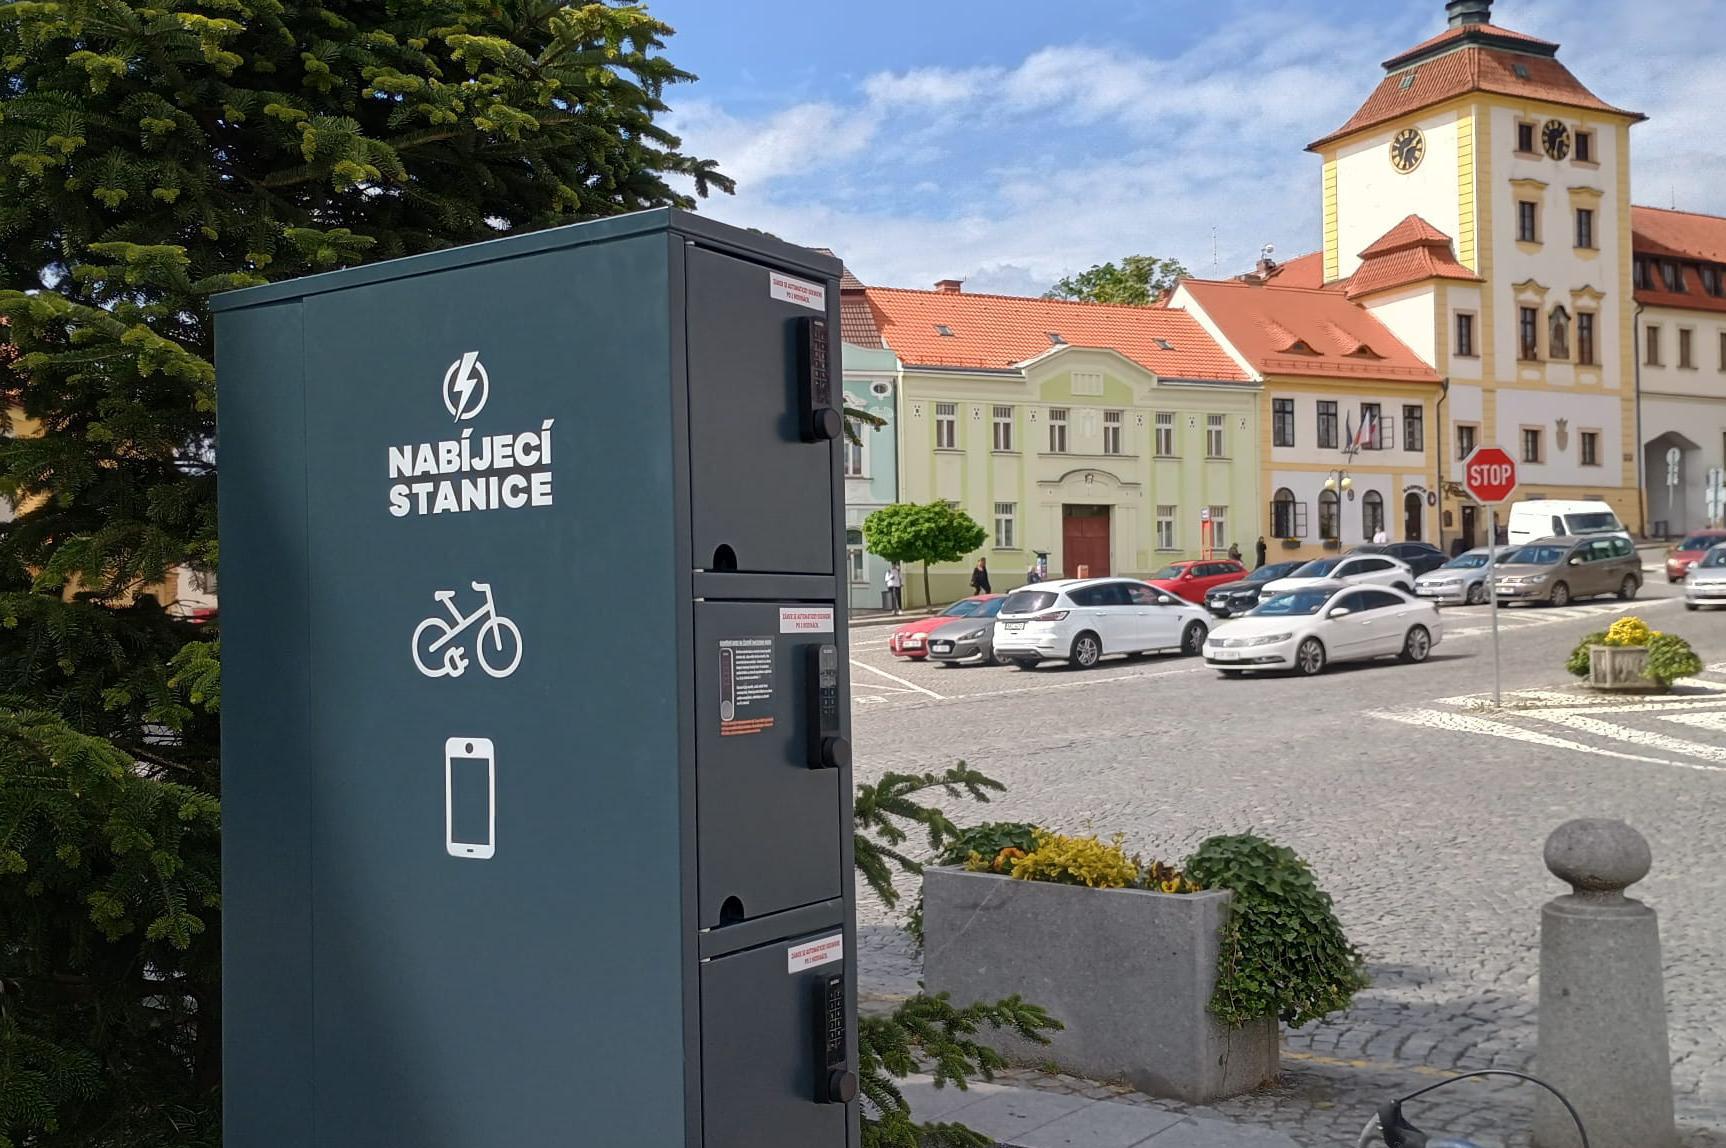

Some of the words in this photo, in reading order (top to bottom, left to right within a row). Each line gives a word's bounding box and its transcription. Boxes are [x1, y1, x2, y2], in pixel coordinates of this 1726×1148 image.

[388, 418, 555, 478] NABÍJECÍ
[389, 471, 553, 517] STANICE
[1470, 464, 1512, 487] STOP
